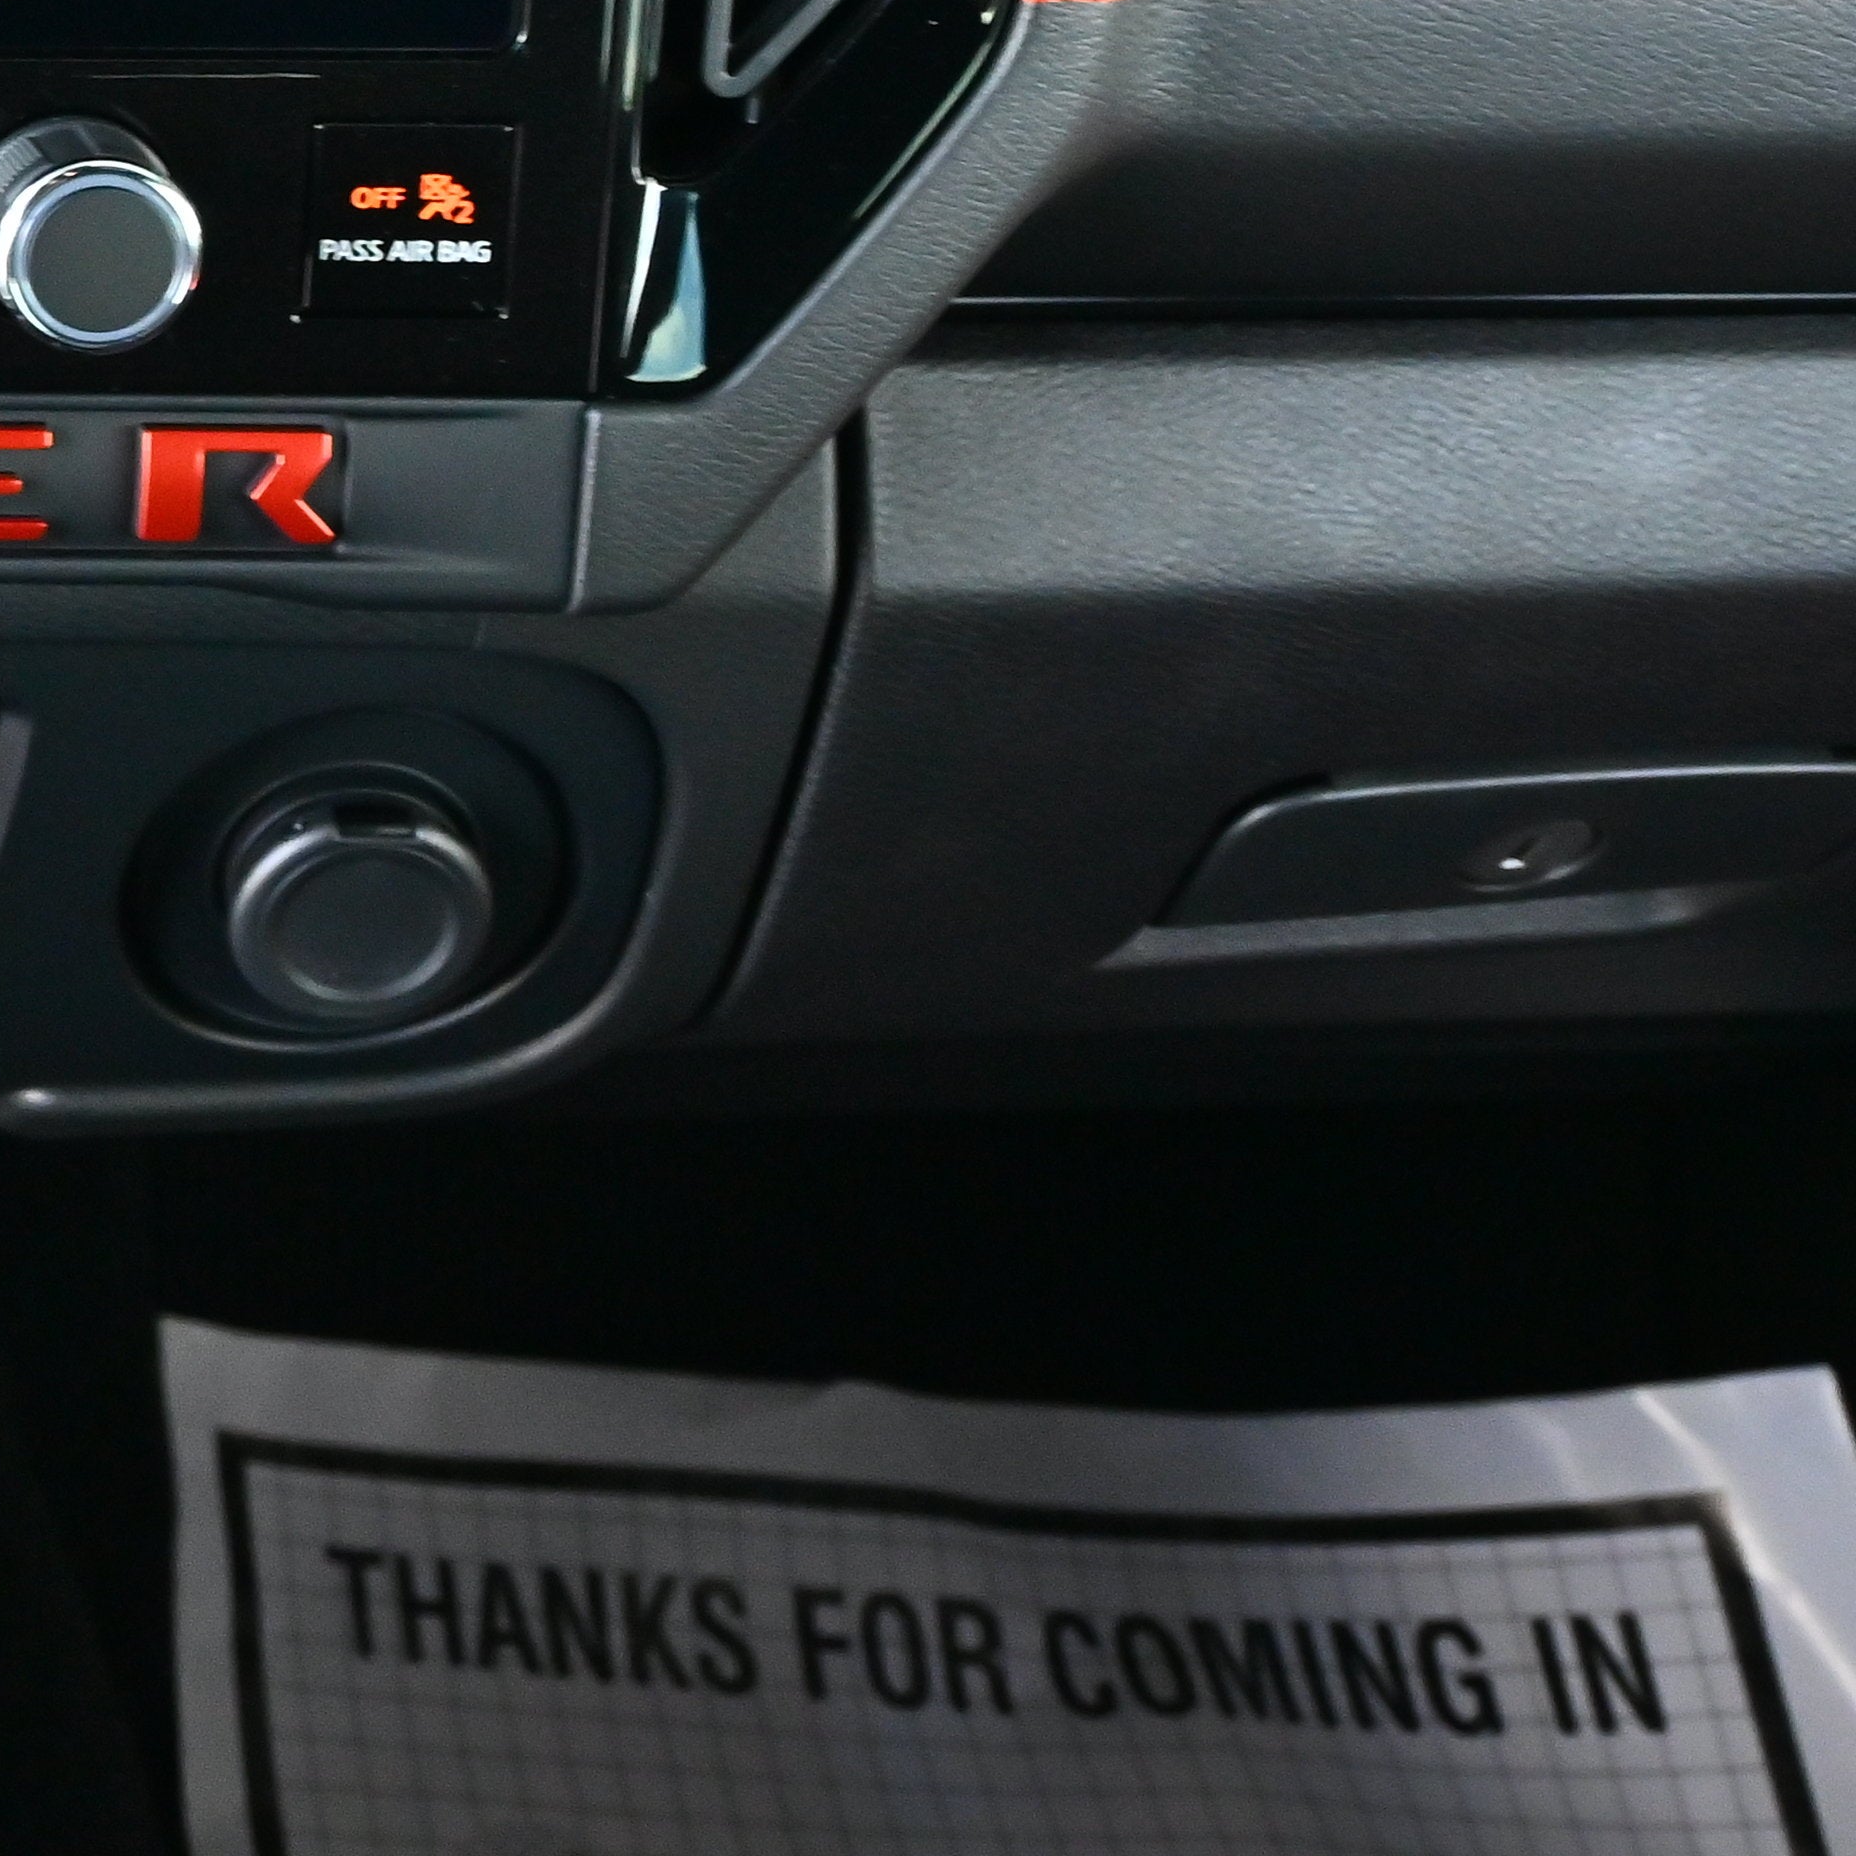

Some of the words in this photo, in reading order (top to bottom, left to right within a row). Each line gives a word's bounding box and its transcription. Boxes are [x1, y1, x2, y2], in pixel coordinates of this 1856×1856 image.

[350, 186, 407, 209] OFF
[319, 238, 385, 262] PASS
[386, 239, 435, 263] AIR
[437, 239, 493, 263] BAG
[324, 1544, 758, 1700] THANKS
[789, 1585, 1018, 1720] FOR
[1043, 1607, 1506, 1740] COMING
[1530, 1607, 1672, 1738] IN
